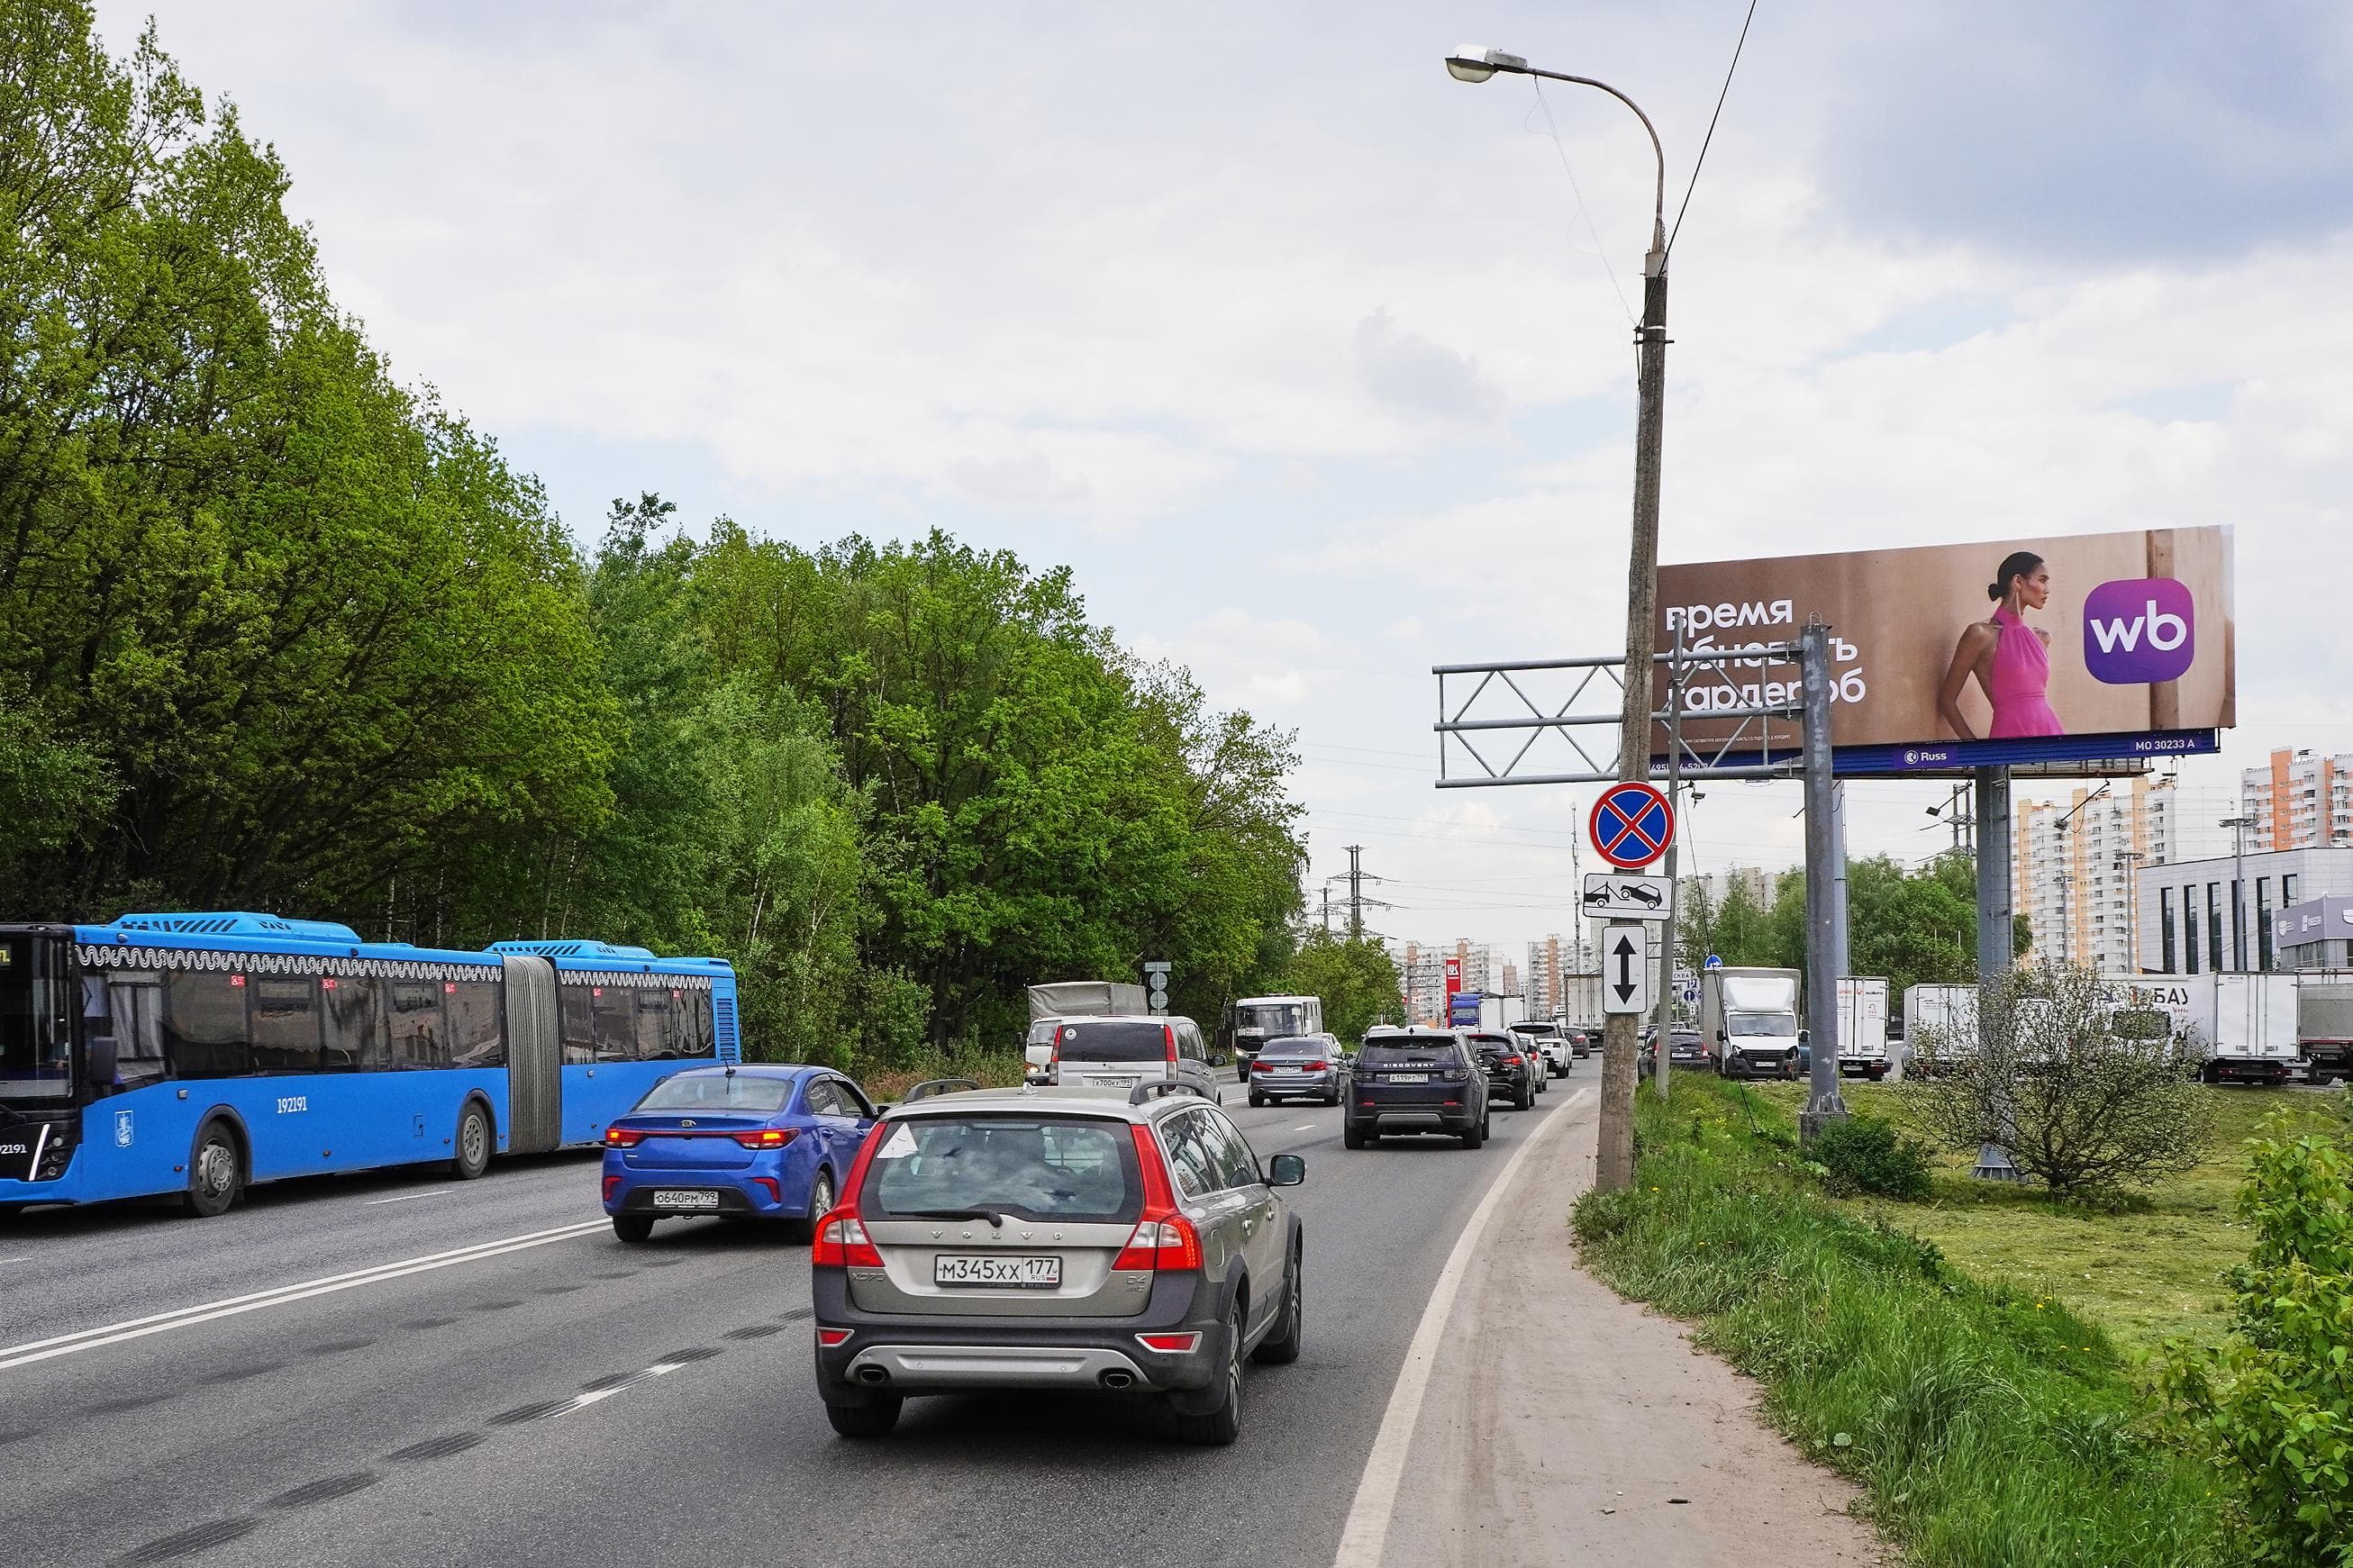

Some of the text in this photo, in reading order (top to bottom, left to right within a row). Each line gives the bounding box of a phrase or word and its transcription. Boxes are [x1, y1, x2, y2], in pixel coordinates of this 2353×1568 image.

[1667, 600, 1793, 638] время
[2090, 600, 2186, 653] wb
[2154, 739, 2185, 749] 30233
[1921, 752, 1947, 761] Russ
[277, 1096, 307, 1113] 192191
[931, 1230, 1063, 1240] VOLVO
[942, 1259, 1054, 1280] М345ХХ 177
